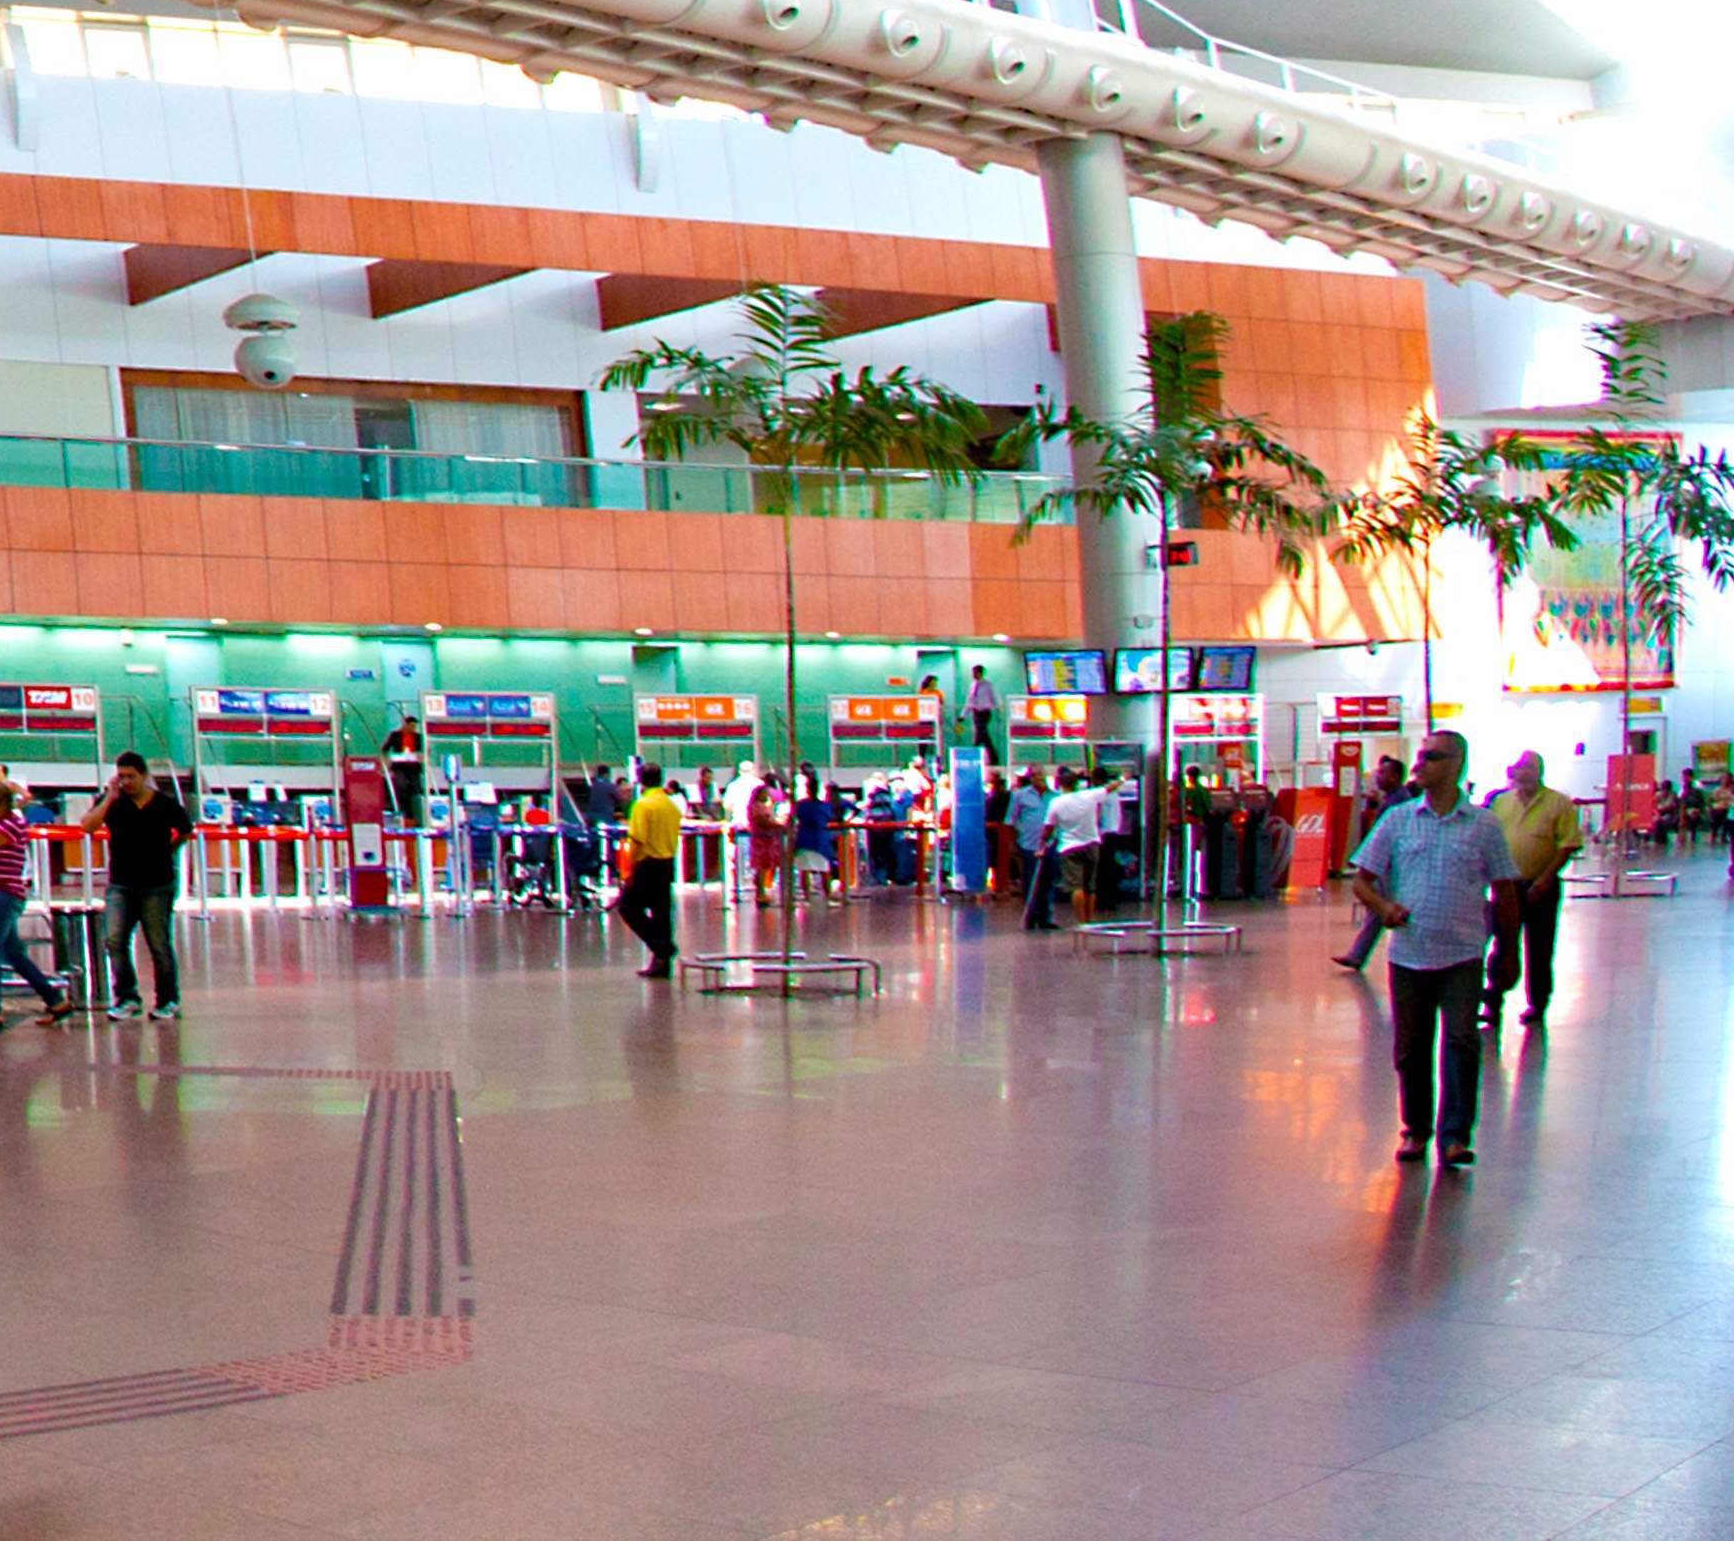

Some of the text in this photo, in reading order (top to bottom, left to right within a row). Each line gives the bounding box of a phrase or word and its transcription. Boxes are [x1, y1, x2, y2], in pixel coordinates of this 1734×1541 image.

[27, 689, 68, 705] TAM
[74, 692, 95, 706] 10
[199, 694, 217, 708] 11
[312, 696, 330, 711] 12
[1295, 812, 1327, 835] GOL
